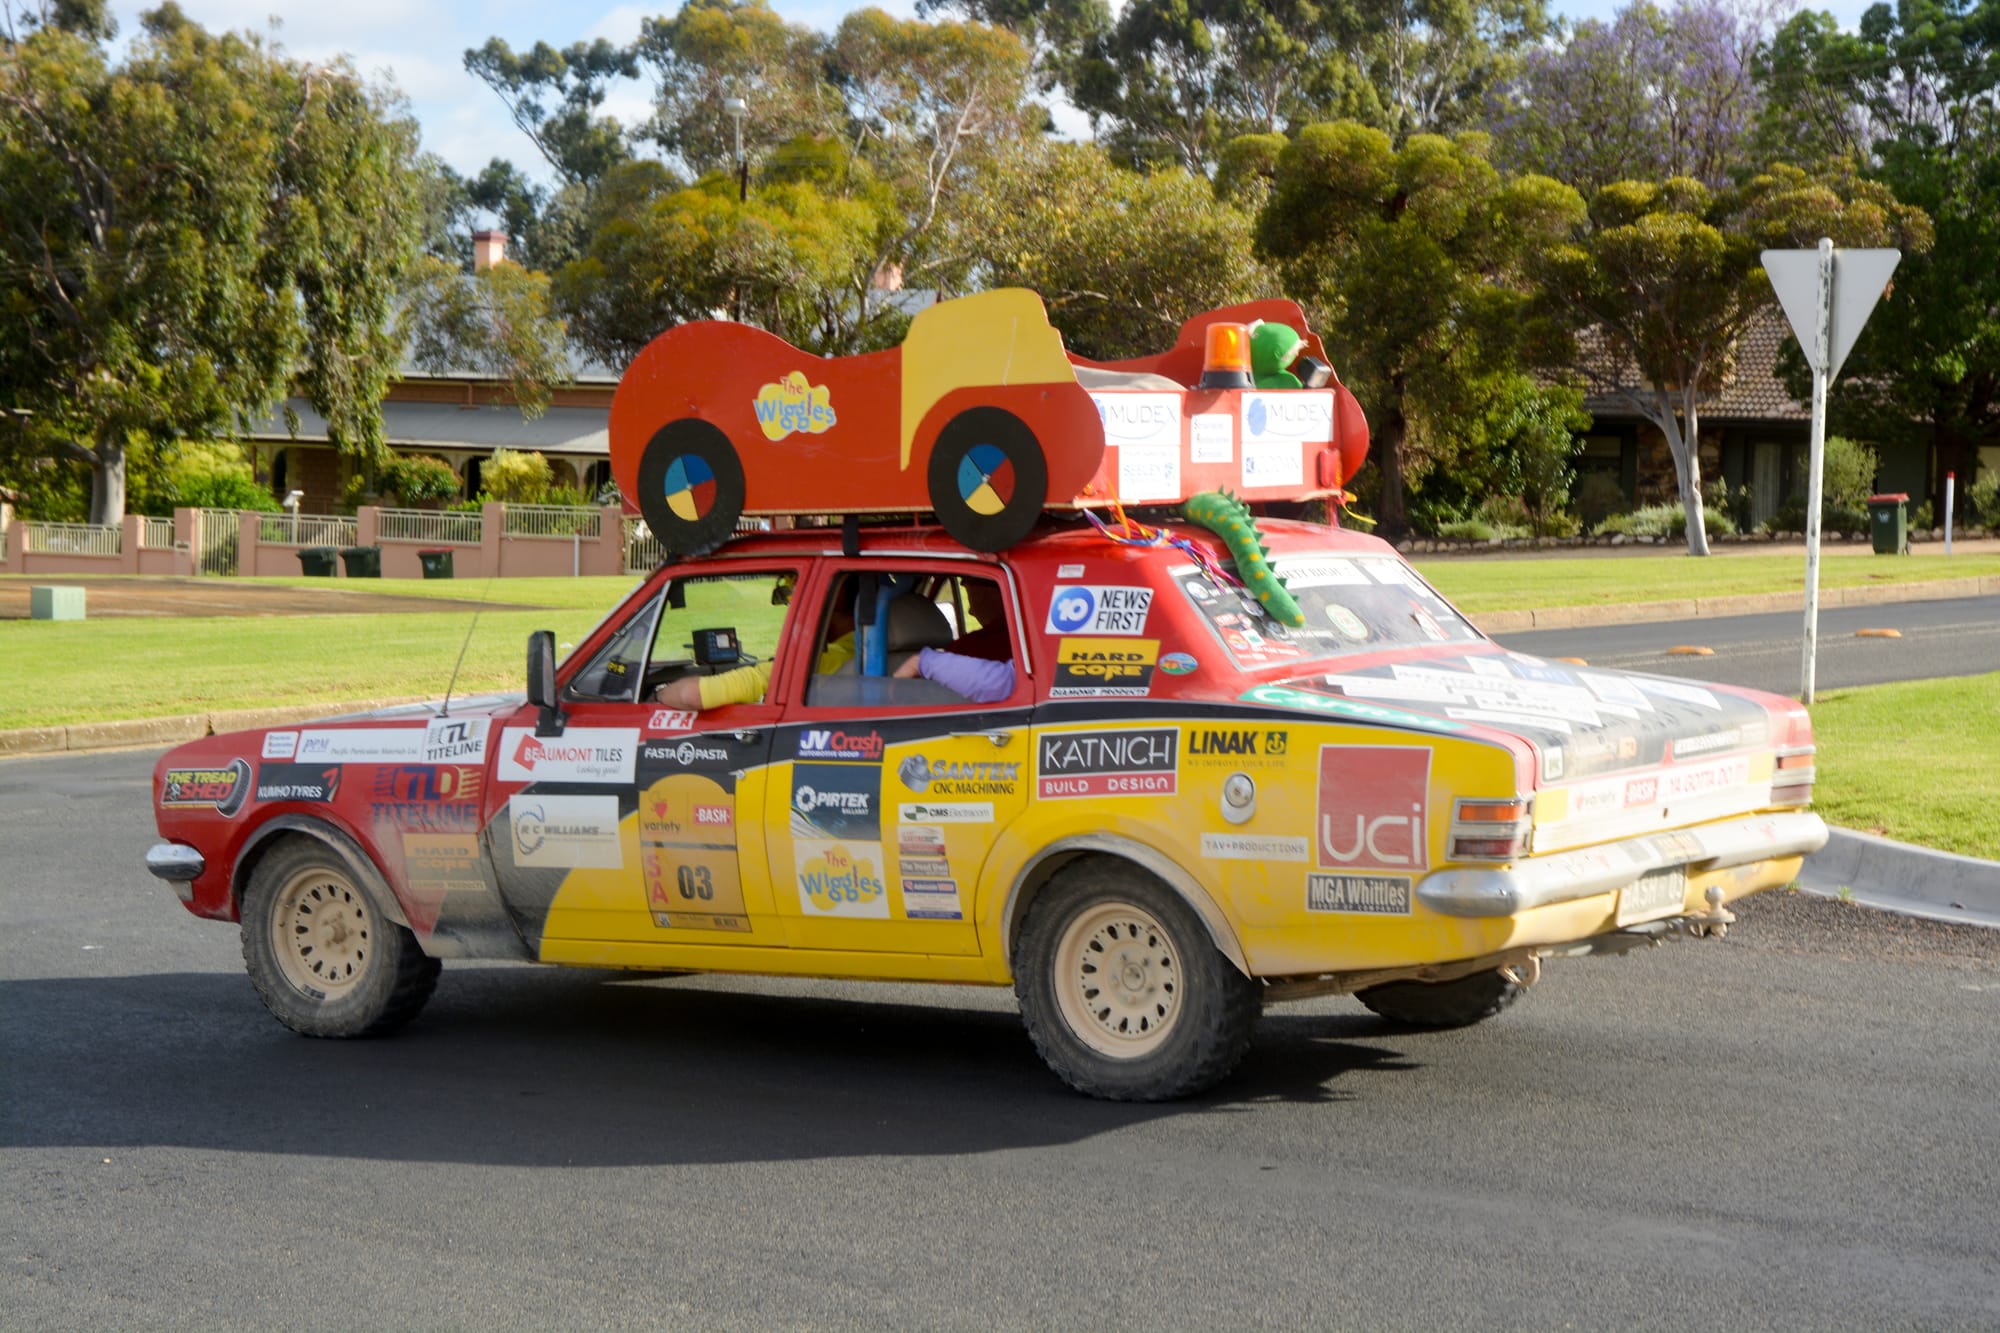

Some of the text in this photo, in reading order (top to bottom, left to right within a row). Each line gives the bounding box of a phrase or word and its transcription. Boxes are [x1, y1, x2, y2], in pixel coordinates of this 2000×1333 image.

[780, 376, 803, 394] The
[753, 393, 835, 431] Wiggles
[1110, 405, 1177, 424] MUDEX
[1270, 404, 1332, 423] MUDEX
[1100, 590, 1151, 611] NEWS
[1057, 598, 1088, 622] 10
[1095, 611, 1147, 632] FIRST
[1072, 652, 1144, 661] HARD
[1068, 664, 1143, 682] CORE
[800, 729, 883, 751] JV Crash
[1188, 730, 1258, 754] LINAK
[427, 740, 482, 761] TITELINE
[524, 747, 623, 762] BEAUMONT TILES
[644, 747, 677, 759] FASTA
[695, 748, 728, 760] PASTA
[1044, 735, 1171, 769] KATNICH
[169, 771, 238, 784] THE TREAD
[931, 759, 1023, 781] SANTEK
[179, 783, 233, 799] SHED
[257, 785, 323, 798] KUMHO TYRES
[933, 783, 1015, 795] CNC MACHINING
[1045, 776, 1169, 794] BUILD DESIGN
[816, 791, 870, 808] PIRTEK
[371, 802, 478, 826] TITELINE
[697, 808, 727, 823] BASH
[929, 808, 948, 817] CMS
[521, 825, 600, 835] R C WILLIAMS
[644, 820, 681, 834] variety
[1205, 840, 1305, 854] TAV PRODUCTIONS
[824, 850, 848, 868] The
[677, 864, 714, 901] 03
[798, 866, 883, 902] Wiggles
[1312, 878, 1406, 906] MGA Whittles
